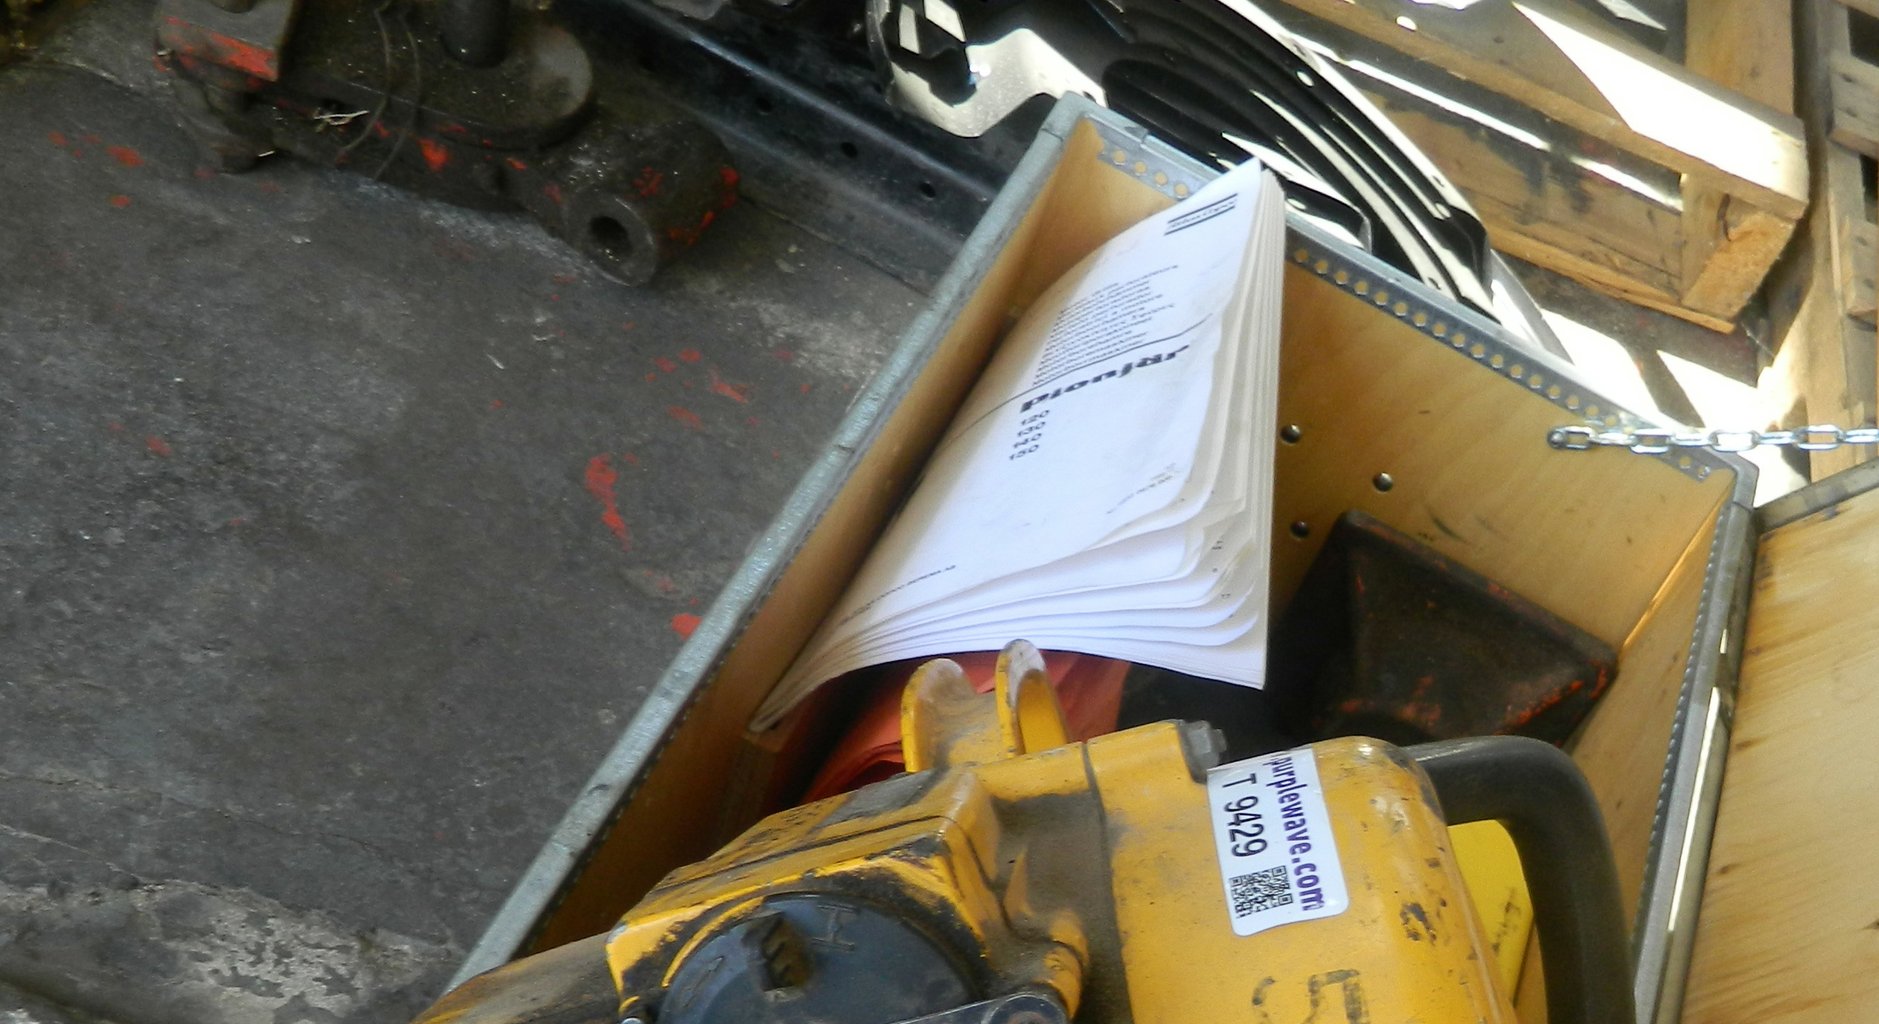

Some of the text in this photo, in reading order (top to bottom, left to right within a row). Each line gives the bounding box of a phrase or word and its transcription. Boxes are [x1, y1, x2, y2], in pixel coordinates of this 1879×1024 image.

[1222, 773, 1267, 857] T 9429
[1263, 757, 1325, 910] purplewave.com
